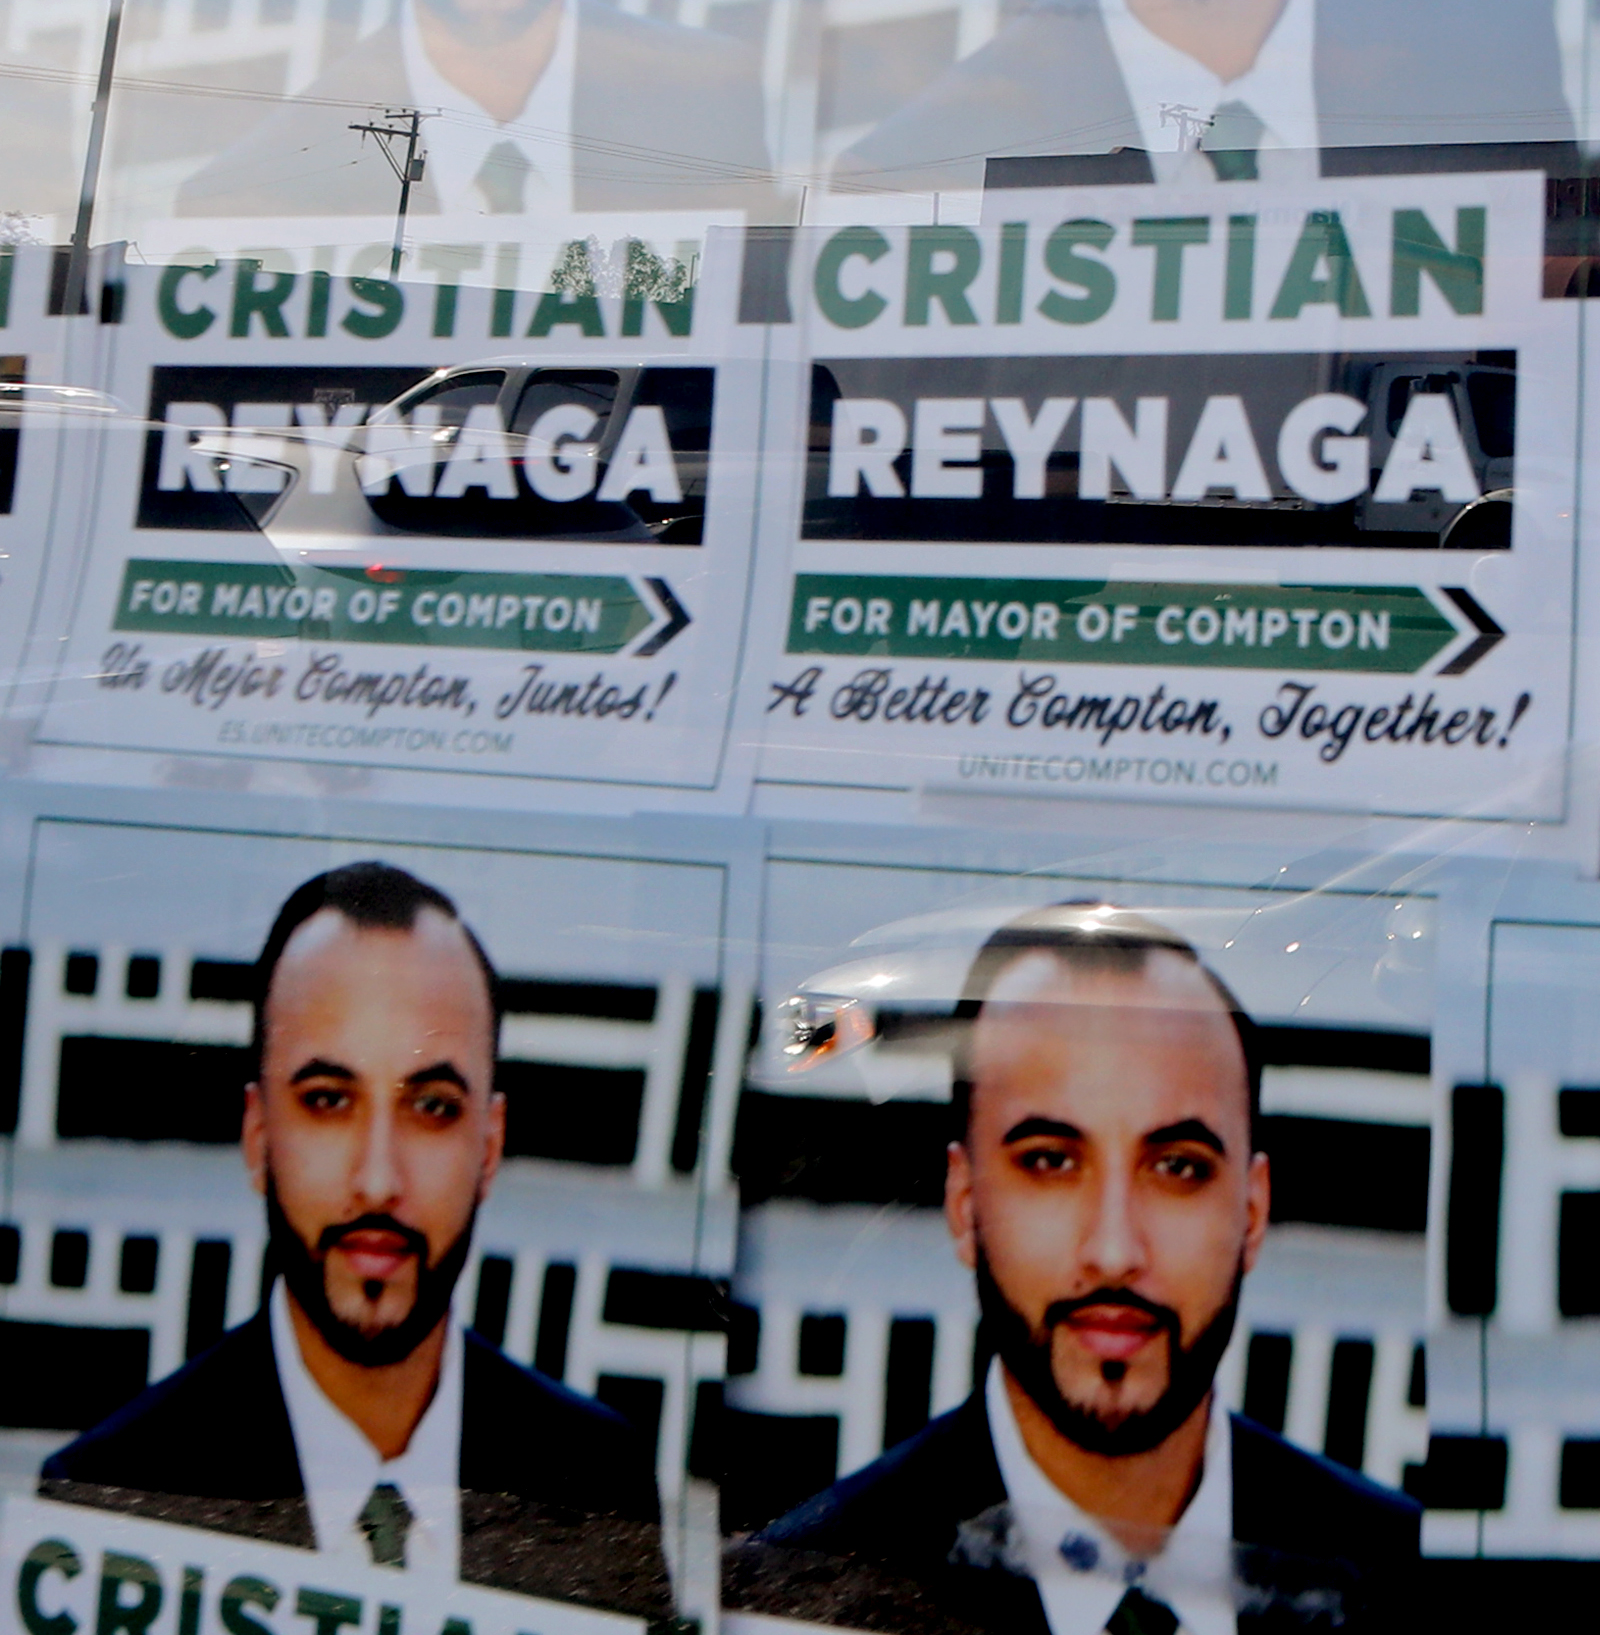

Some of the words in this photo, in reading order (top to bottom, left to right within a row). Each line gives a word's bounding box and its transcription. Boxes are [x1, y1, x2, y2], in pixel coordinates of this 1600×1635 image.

[155, 238, 697, 341] CRISTIAN
[812, 204, 1487, 331] CRISTIAN
[157, 400, 684, 503] REYNAGA
[826, 394, 1484, 505] REYNAGA
[127, 579, 198, 617] FOR
[210, 583, 335, 622] MAYOR
[348, 589, 400, 626] OF
[411, 591, 602, 635] COMPTON
[803, 597, 891, 637] FOR
[905, 600, 1060, 642] MAYOR
[1076, 605, 1137, 645] OF
[1155, 607, 1391, 651] COMPTON
[100, 641, 150, 691] Un
[163, 647, 280, 712] Mejor
[295, 653, 479, 720] Compton,
[496, 665, 678, 723] Juntos!
[766, 666, 824, 719] A
[830, 667, 991, 727] Better
[1006, 669, 1232, 748] Compton,
[1259, 681, 1533, 764] Together!
[216, 721, 514, 756] ES.UNITECOMPTON.COM
[957, 753, 1279, 788] UNITECOMPTON.COM
